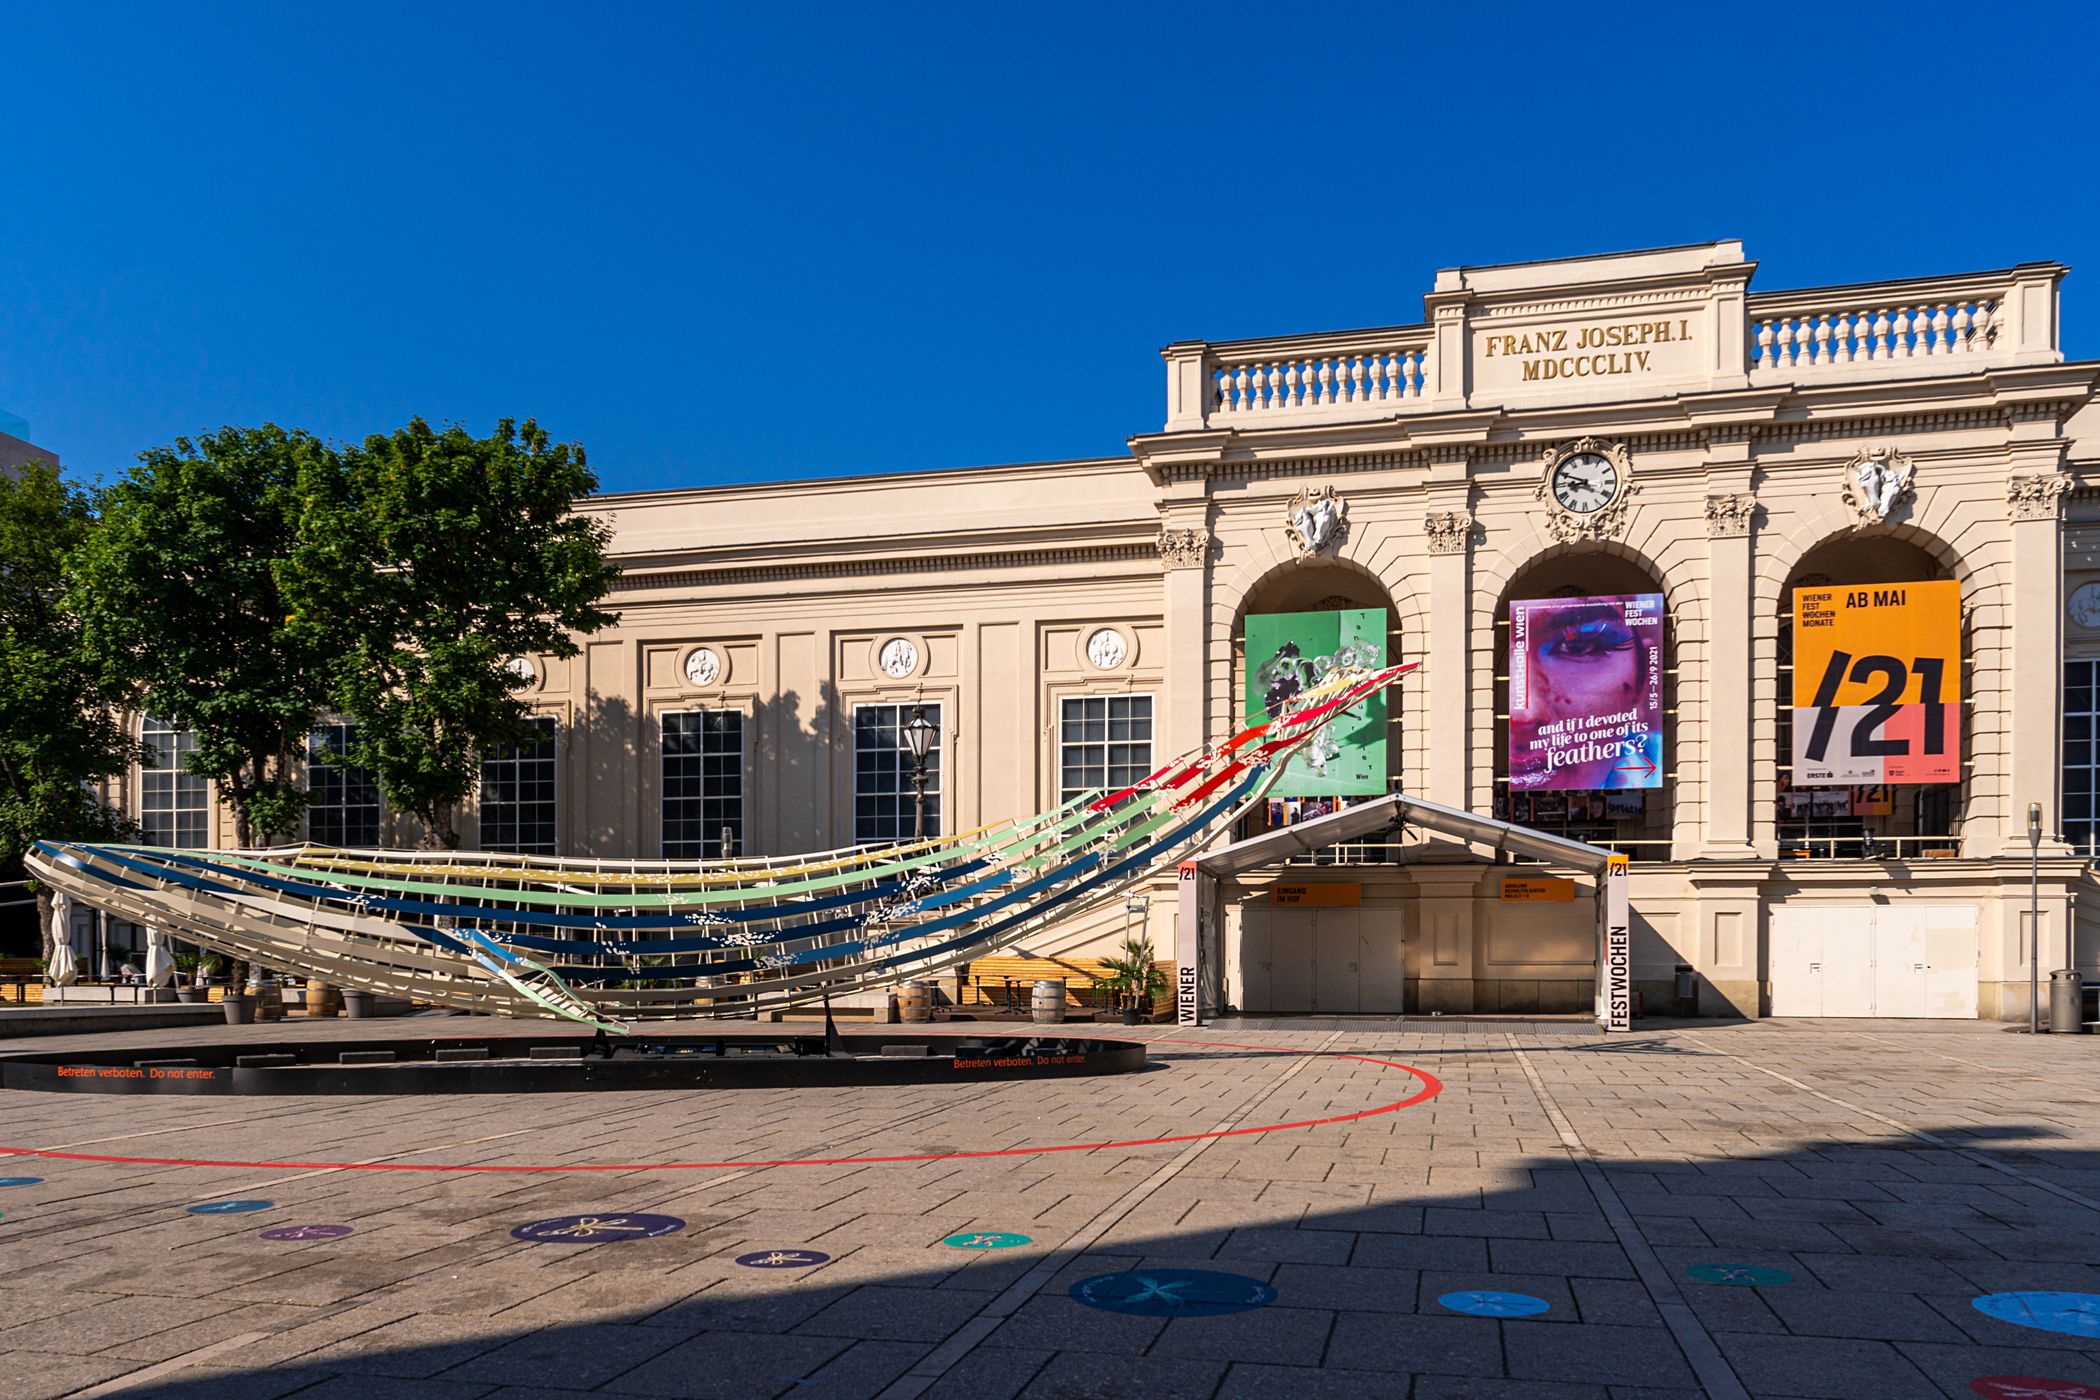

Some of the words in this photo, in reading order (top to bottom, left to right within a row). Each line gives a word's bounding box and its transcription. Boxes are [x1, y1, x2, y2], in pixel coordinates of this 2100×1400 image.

[1485, 329, 1568, 358] FRANZ
[1521, 350, 1652, 382] MDCCCLIV.
[1625, 600, 1655, 609] WIENER
[1802, 593, 1832, 602] WIENER
[1845, 592, 1869, 609] AB
[1873, 589, 1906, 608] MAI
[1625, 609, 1643, 618] FEST
[1802, 602, 1820, 610] FEST
[1625, 617, 1658, 627] WOCHEN
[1802, 610, 1836, 619] WOCHEN
[1802, 618, 1834, 627] MONATE
[1649, 646, 1658, 665] 2021
[1804, 649, 1945, 763] /21
[1538, 720, 1564, 736] and
[1566, 718, 1576, 733] if
[1577, 717, 1584, 730] I
[1585, 708, 1638, 728] devoted
[1529, 738, 1549, 751] my
[1551, 732, 1572, 748] life
[1574, 731, 1588, 743] to
[1589, 726, 1614, 740] one
[1615, 722, 1632, 737] of
[1631, 721, 1649, 733] its
[1543, 733, 1648, 774] feathers?
[1179, 866, 1195, 881] /21
[1609, 862, 1627, 877] /21
[1277, 887, 1306, 895] EINGANG
[1287, 895, 1300, 903] HOF
[1610, 926, 1628, 1028] FESTWOCHEN
[1180, 966, 1195, 1023] WIENER
[953, 1059, 991, 1069] Betreten
[994, 1057, 1034, 1067] verboten.
[1037, 1055, 1049, 1065] Do
[1051, 1055, 1065, 1065] not
[57, 1066, 96, 1077] Betreten
[98, 1067, 146, 1079] verboten.
[149, 1068, 165, 1079] Do
[167, 1069, 184, 1079] not
[186, 1070, 216, 1080] enter.
